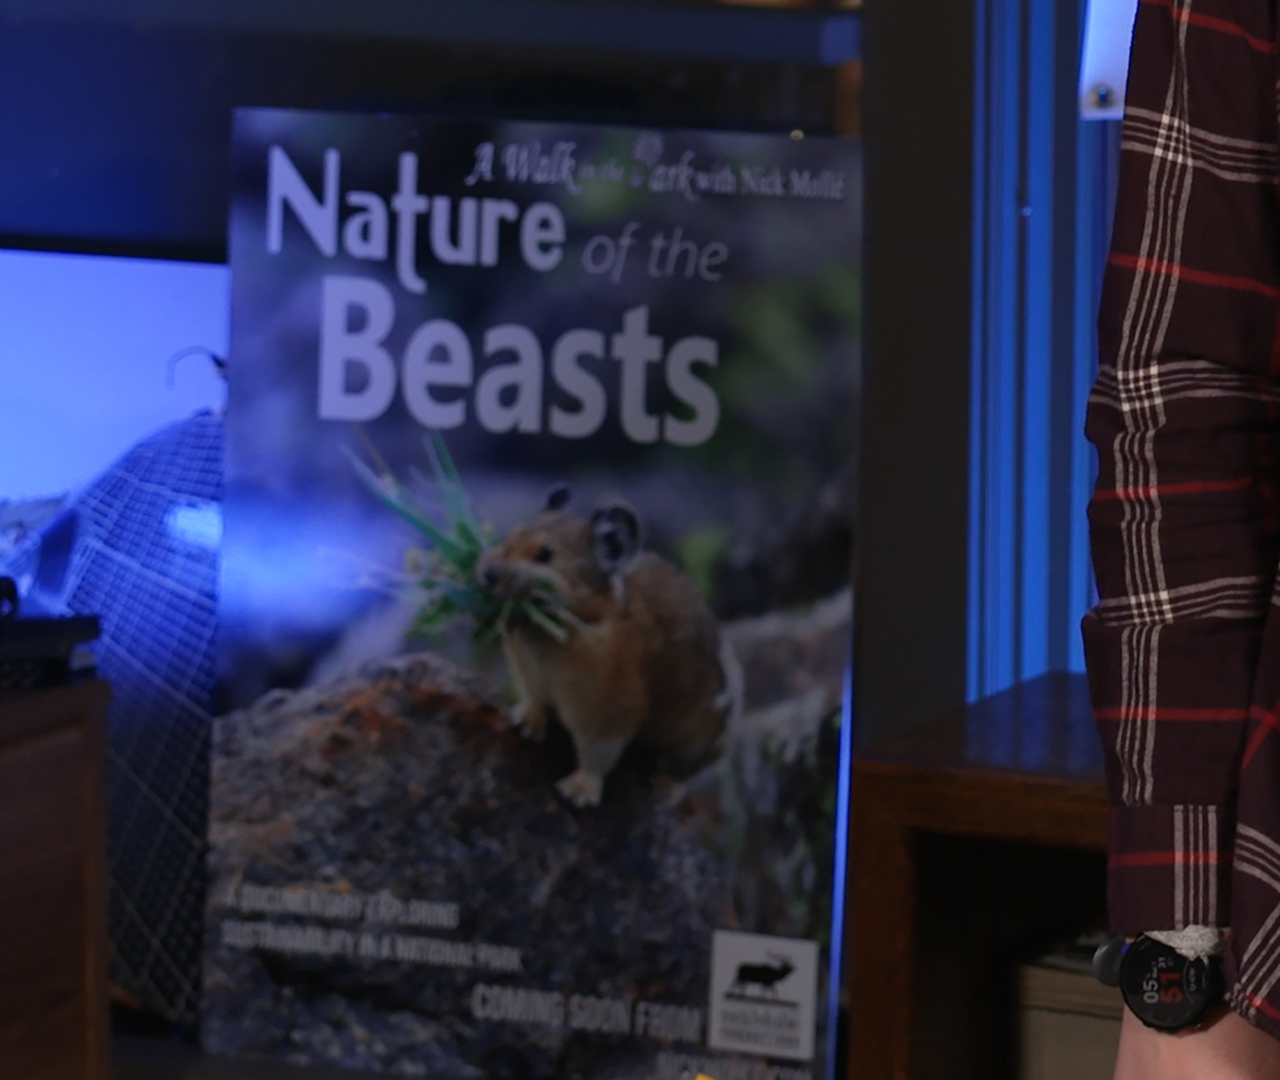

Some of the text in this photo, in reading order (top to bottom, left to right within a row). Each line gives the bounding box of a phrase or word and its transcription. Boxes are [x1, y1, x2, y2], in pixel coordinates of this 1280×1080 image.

[266, 145, 729, 294] Nature of the
[499, 138, 582, 196] Walk
[316, 274, 721, 447] Beasts
[470, 981, 565, 1027] COMING
[568, 991, 631, 1035] SOON
[635, 999, 702, 1043] FROM
